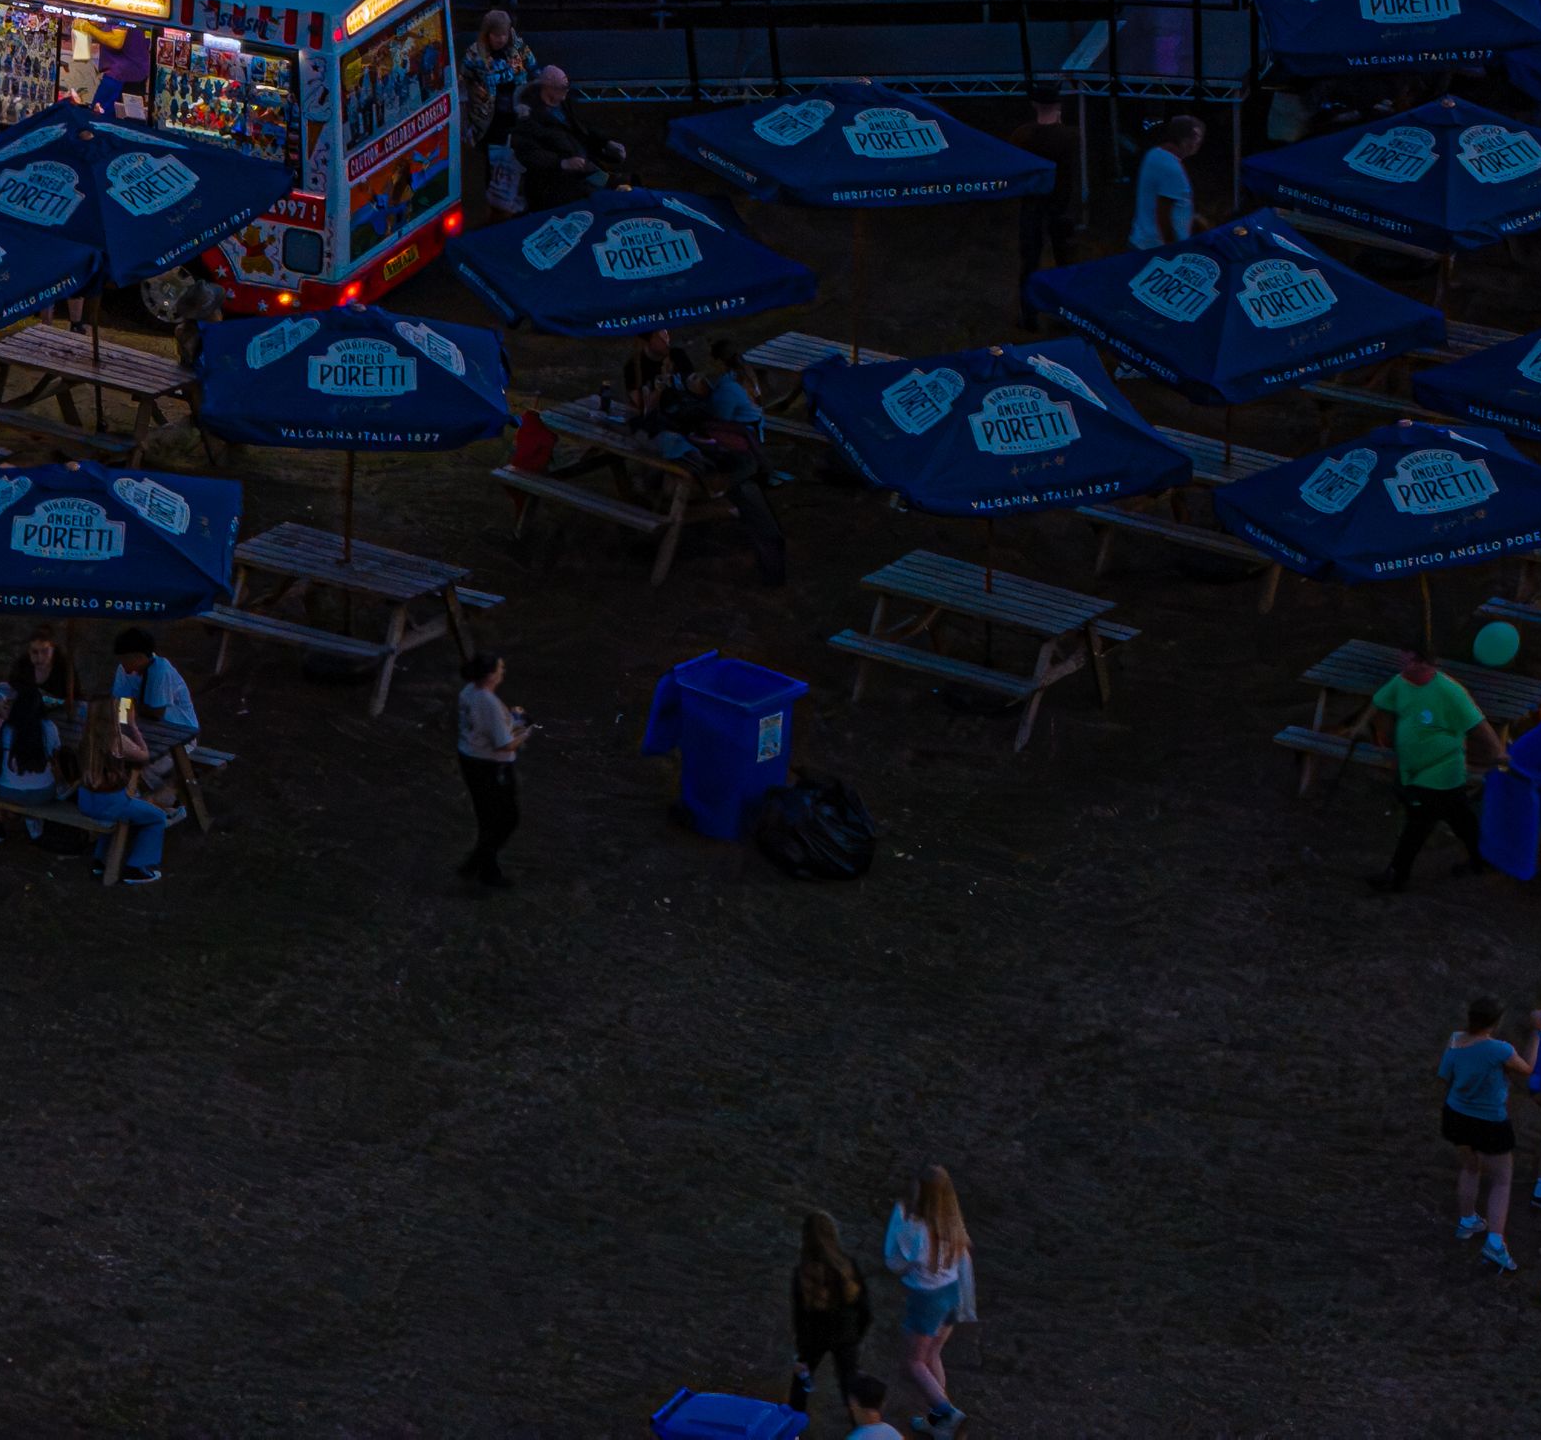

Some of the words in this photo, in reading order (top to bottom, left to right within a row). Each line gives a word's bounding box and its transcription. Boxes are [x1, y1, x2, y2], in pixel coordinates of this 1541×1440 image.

[384, 121, 416, 153] CHILDREN
[417, 98, 448, 133] CROSSING
[868, 118, 909, 131] ANGELO
[857, 128, 936, 151] PORETTI
[1362, 142, 1424, 176] PORETTI
[1469, 141, 1539, 175] PORETTI
[121, 164, 187, 207] PORETTI
[832, 187, 898, 201] BIRRIFICIO
[902, 182, 951, 196] ANGELO
[957, 180, 1008, 193] PORETTI
[620, 230, 662, 247] ANGELO
[606, 239, 691, 271] PORETTI
[1140, 269, 1207, 313] PORETTI
[1257, 272, 1294, 291] ANGELO
[2, 296, 36, 319] ANGELO
[39, 276, 78, 302] PORETTI
[1250, 279, 1325, 319] PORETTI
[596, 314, 665, 328] VALGANNA
[667, 304, 710, 319] ITALIA
[341, 353, 384, 364] ANGELO
[1263, 364, 1321, 384] VALGANNA
[1322, 352, 1357, 370] ITALIA
[320, 364, 405, 386] PORETTI
[989, 388, 1042, 405] BIRRIFICIO
[997, 400, 1040, 417] ANGELO
[281, 428, 354, 440] VALGANNA
[358, 431, 402, 442] ITALIA
[982, 411, 1069, 446] PORETTI
[970, 495, 1039, 510] VALGANNA
[1043, 488, 1083, 502] ITALIA
[1088, 481, 1120, 496] 1877
[1398, 472, 1485, 506] PORETTI
[43, 502, 100, 515] BIRRIFICIO
[47, 514, 93, 527] ANGELO
[24, 526, 113, 551] PORETTI
[1375, 552, 1444, 572] BIRRIFICIO
[1449, 542, 1502, 560] ANGELO
[42, 596, 99, 608] ANGELO
[105, 600, 167, 611] PORETTI
